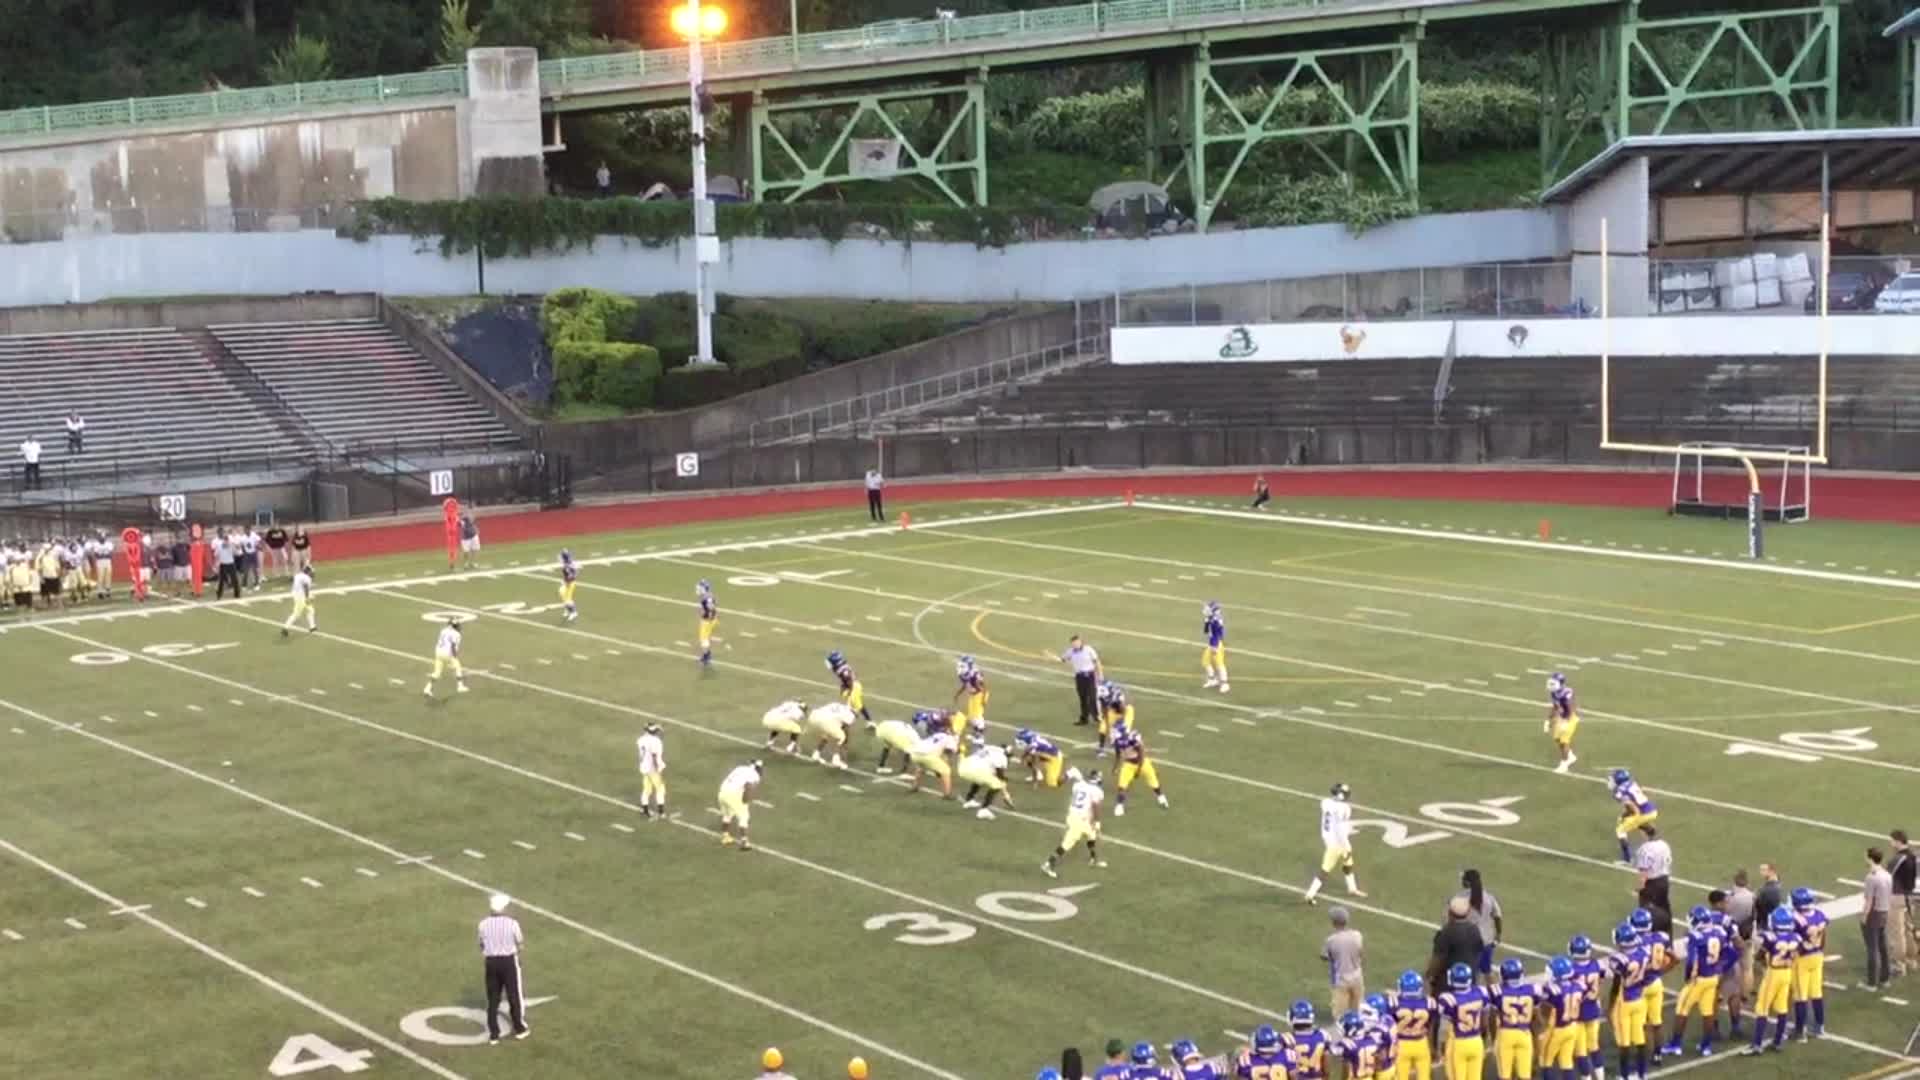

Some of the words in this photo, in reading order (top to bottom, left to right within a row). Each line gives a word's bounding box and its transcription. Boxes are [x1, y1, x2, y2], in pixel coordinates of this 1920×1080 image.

[680, 455, 696, 473] G
[434, 472, 451, 492] 10
[162, 497, 184, 517] 20
[1346, 802, 1520, 848] 20
[863, 891, 1078, 945] 30
[1707, 937, 1720, 964] 9
[1396, 1008, 1429, 1035] 22
[1458, 1000, 1483, 1032] 57
[1502, 996, 1533, 1023] 53
[268, 1006, 515, 1076] 40
